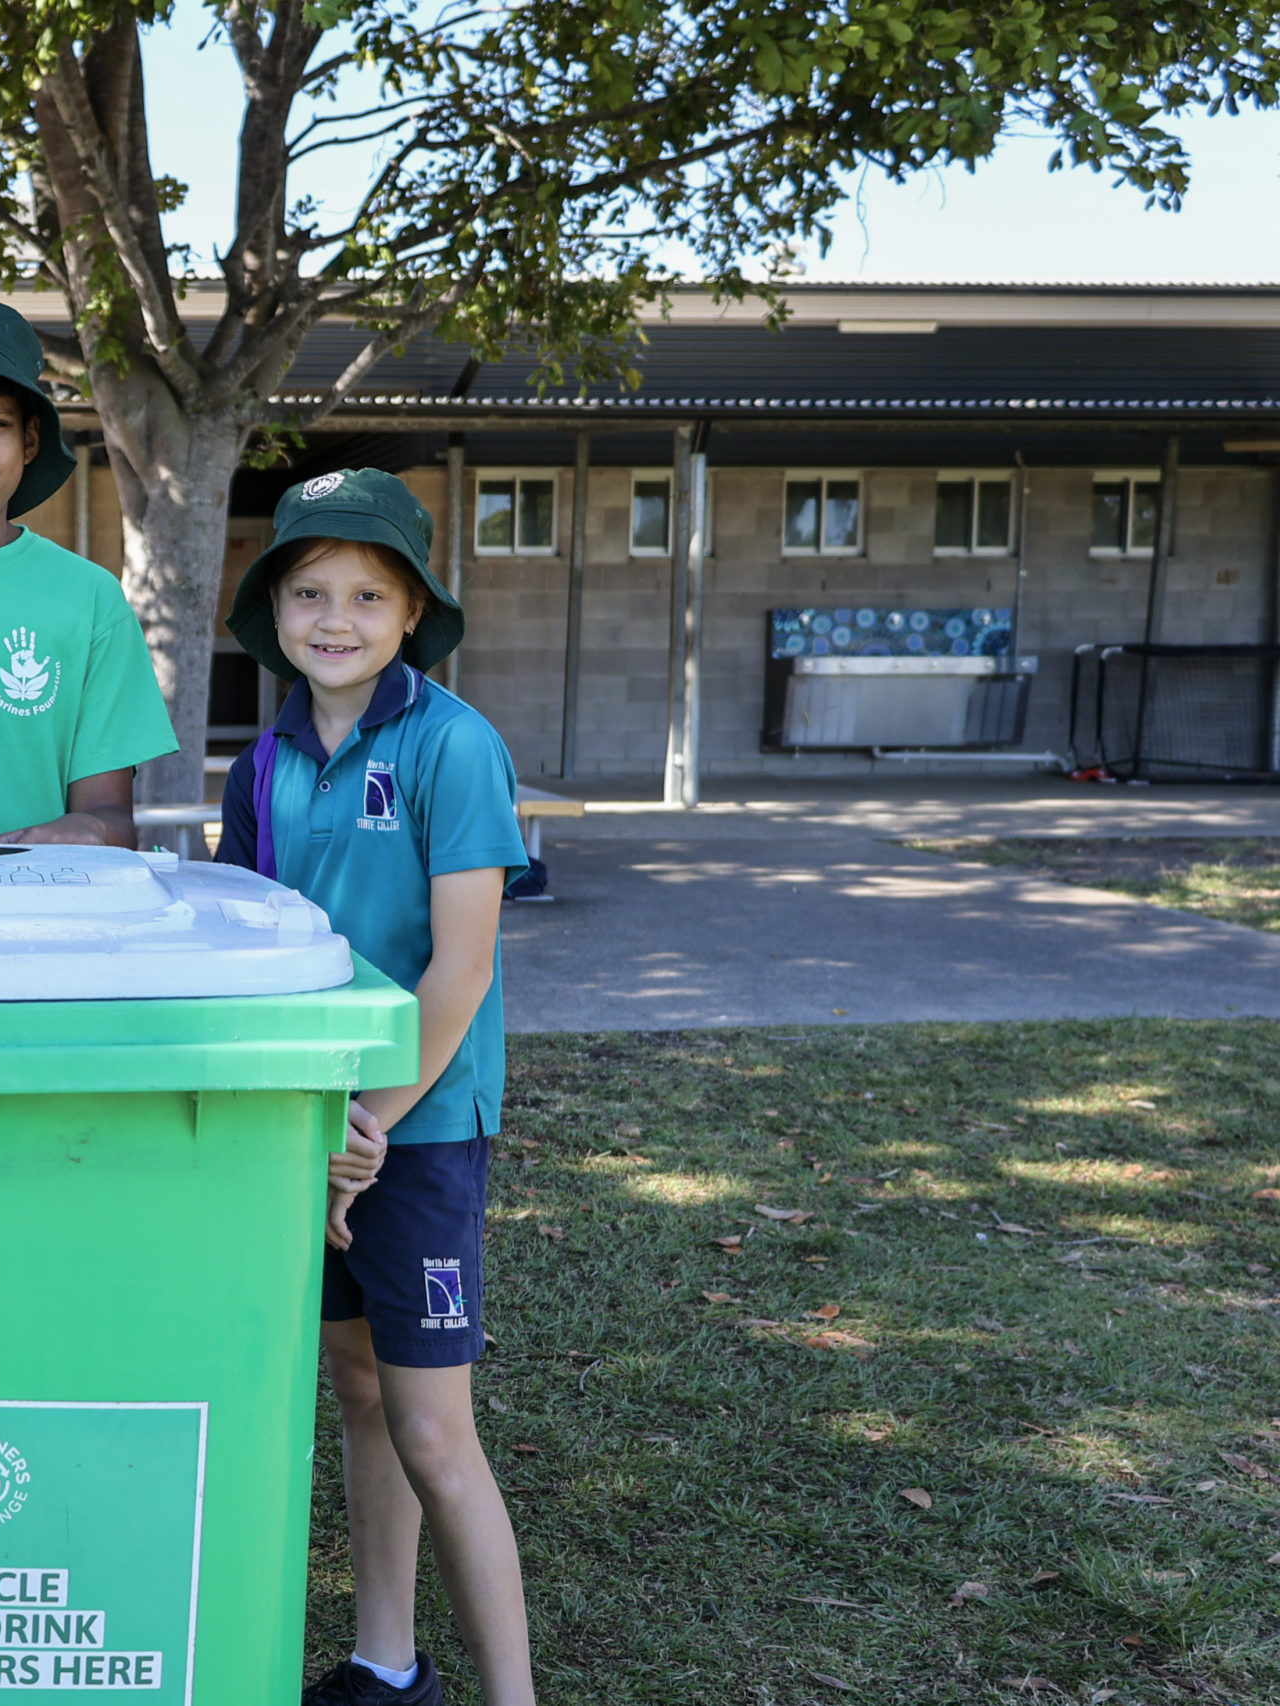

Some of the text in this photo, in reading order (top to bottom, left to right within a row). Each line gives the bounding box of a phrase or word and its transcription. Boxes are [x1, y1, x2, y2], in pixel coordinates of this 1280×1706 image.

[420, 1317, 470, 1329] STATE COLLEGE
[52, 1656, 154, 1685] HERE
